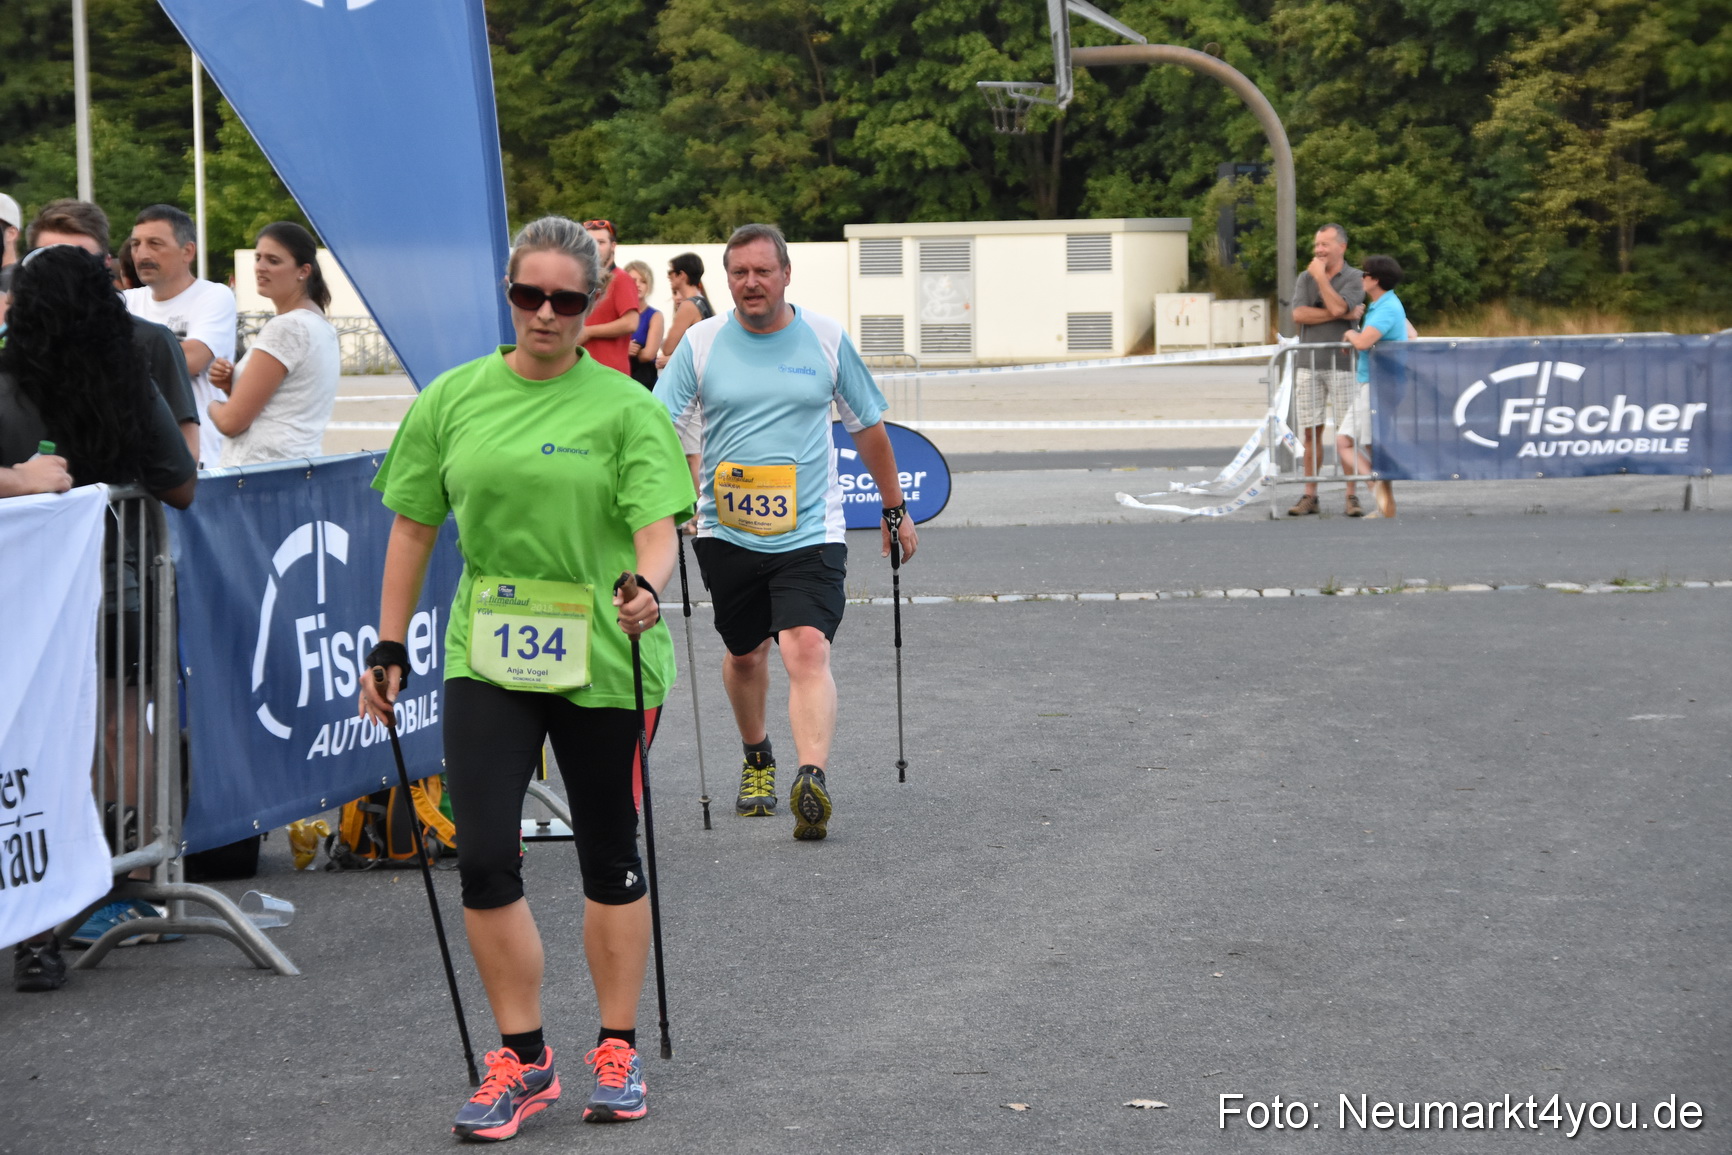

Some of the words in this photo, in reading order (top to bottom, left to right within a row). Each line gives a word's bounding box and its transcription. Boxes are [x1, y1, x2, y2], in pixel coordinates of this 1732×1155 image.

[787, 367, 816, 376] sumida
[1499, 394, 1707, 436] Fischer
[1517, 438, 1690, 458] AUTOMOBILE
[838, 471, 927, 491] scer
[723, 491, 788, 518] 1433
[489, 595, 530, 607] firmenlauf
[494, 623, 566, 661] 134
[296, 606, 437, 708] Fiscer
[507, 667, 524, 675] Anja
[527, 668, 549, 677] Vogel
[0, 768, 28, 810] er
